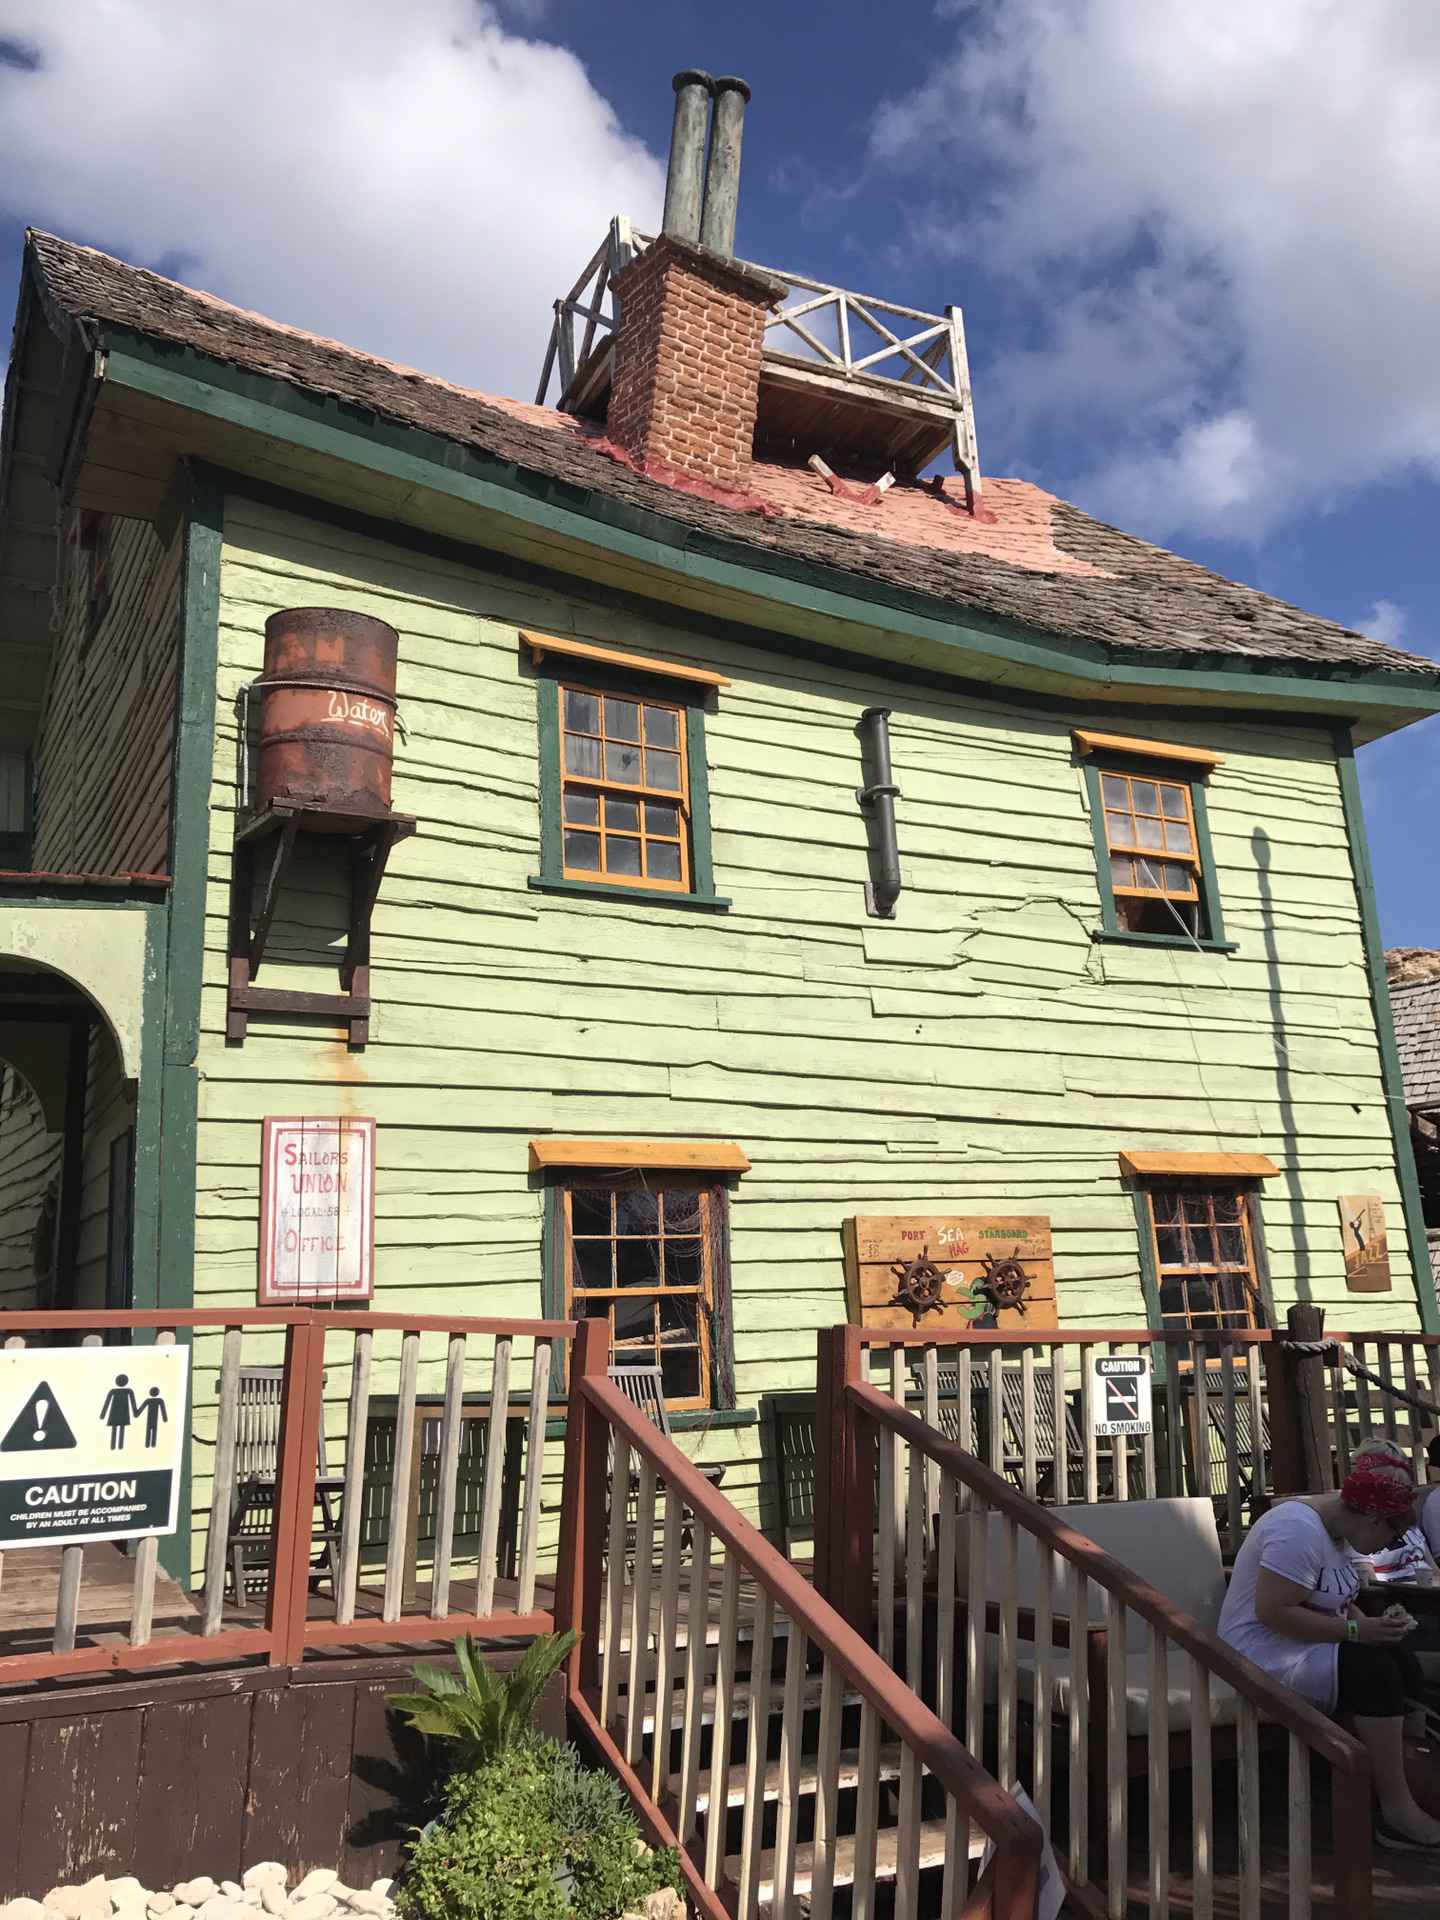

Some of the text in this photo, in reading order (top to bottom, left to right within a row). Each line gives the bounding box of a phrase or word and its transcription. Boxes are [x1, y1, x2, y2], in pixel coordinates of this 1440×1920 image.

[328, 690, 389, 737] Water
[284, 1143, 348, 1166] SAILORS
[290, 1173, 348, 1194] UNION
[284, 1229, 347, 1253] OFFICE
[901, 1230, 926, 1240] PORT
[937, 1225, 965, 1245] SEA
[949, 1242, 969, 1258] HAG
[1101, 1360, 1140, 1373] CAUTION
[1095, 1421, 1151, 1434] NO SMOKING
[25, 1479, 137, 1506] CAUTION
[10, 1512, 52, 1521] CHILDREN
[53, 1510, 76, 1518] MUST
[90, 1504, 147, 1515] ACCOMPANIED
[26, 1521, 37, 1529] BY
[52, 1519, 78, 1527] ADULT
[107, 1514, 131, 1522] TIMES
